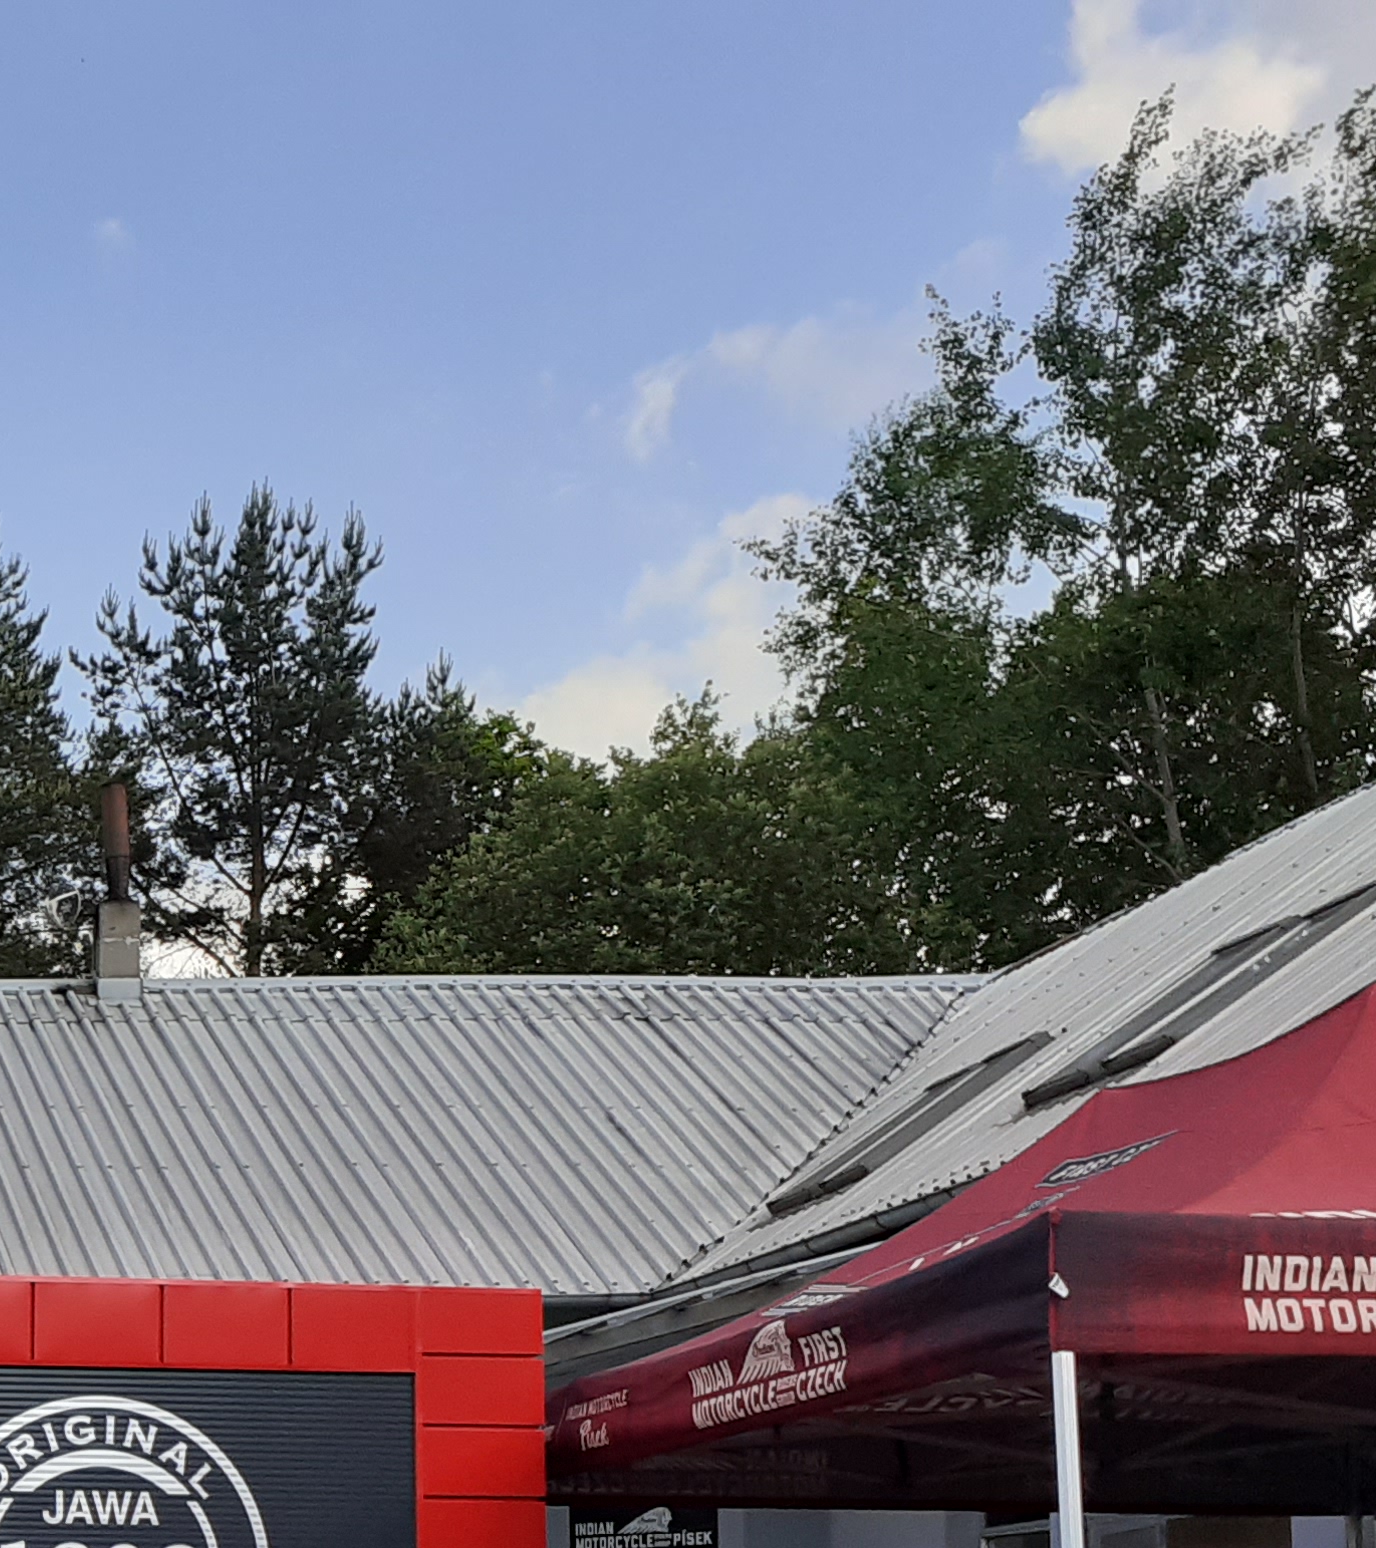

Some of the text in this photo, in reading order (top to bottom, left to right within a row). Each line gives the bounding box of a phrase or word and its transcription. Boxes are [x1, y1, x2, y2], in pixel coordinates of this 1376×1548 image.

[1242, 1255, 1376, 1292] INDIAN
[1243, 1298, 1376, 1333] MOTOR
[688, 1359, 733, 1397] INDIAN
[798, 1326, 847, 1366] FIRST
[691, 1359, 847, 1429] MOTORCYCLE CZECH
[42, 1490, 159, 1525] JAWA
[575, 1521, 614, 1536] INDIAN
